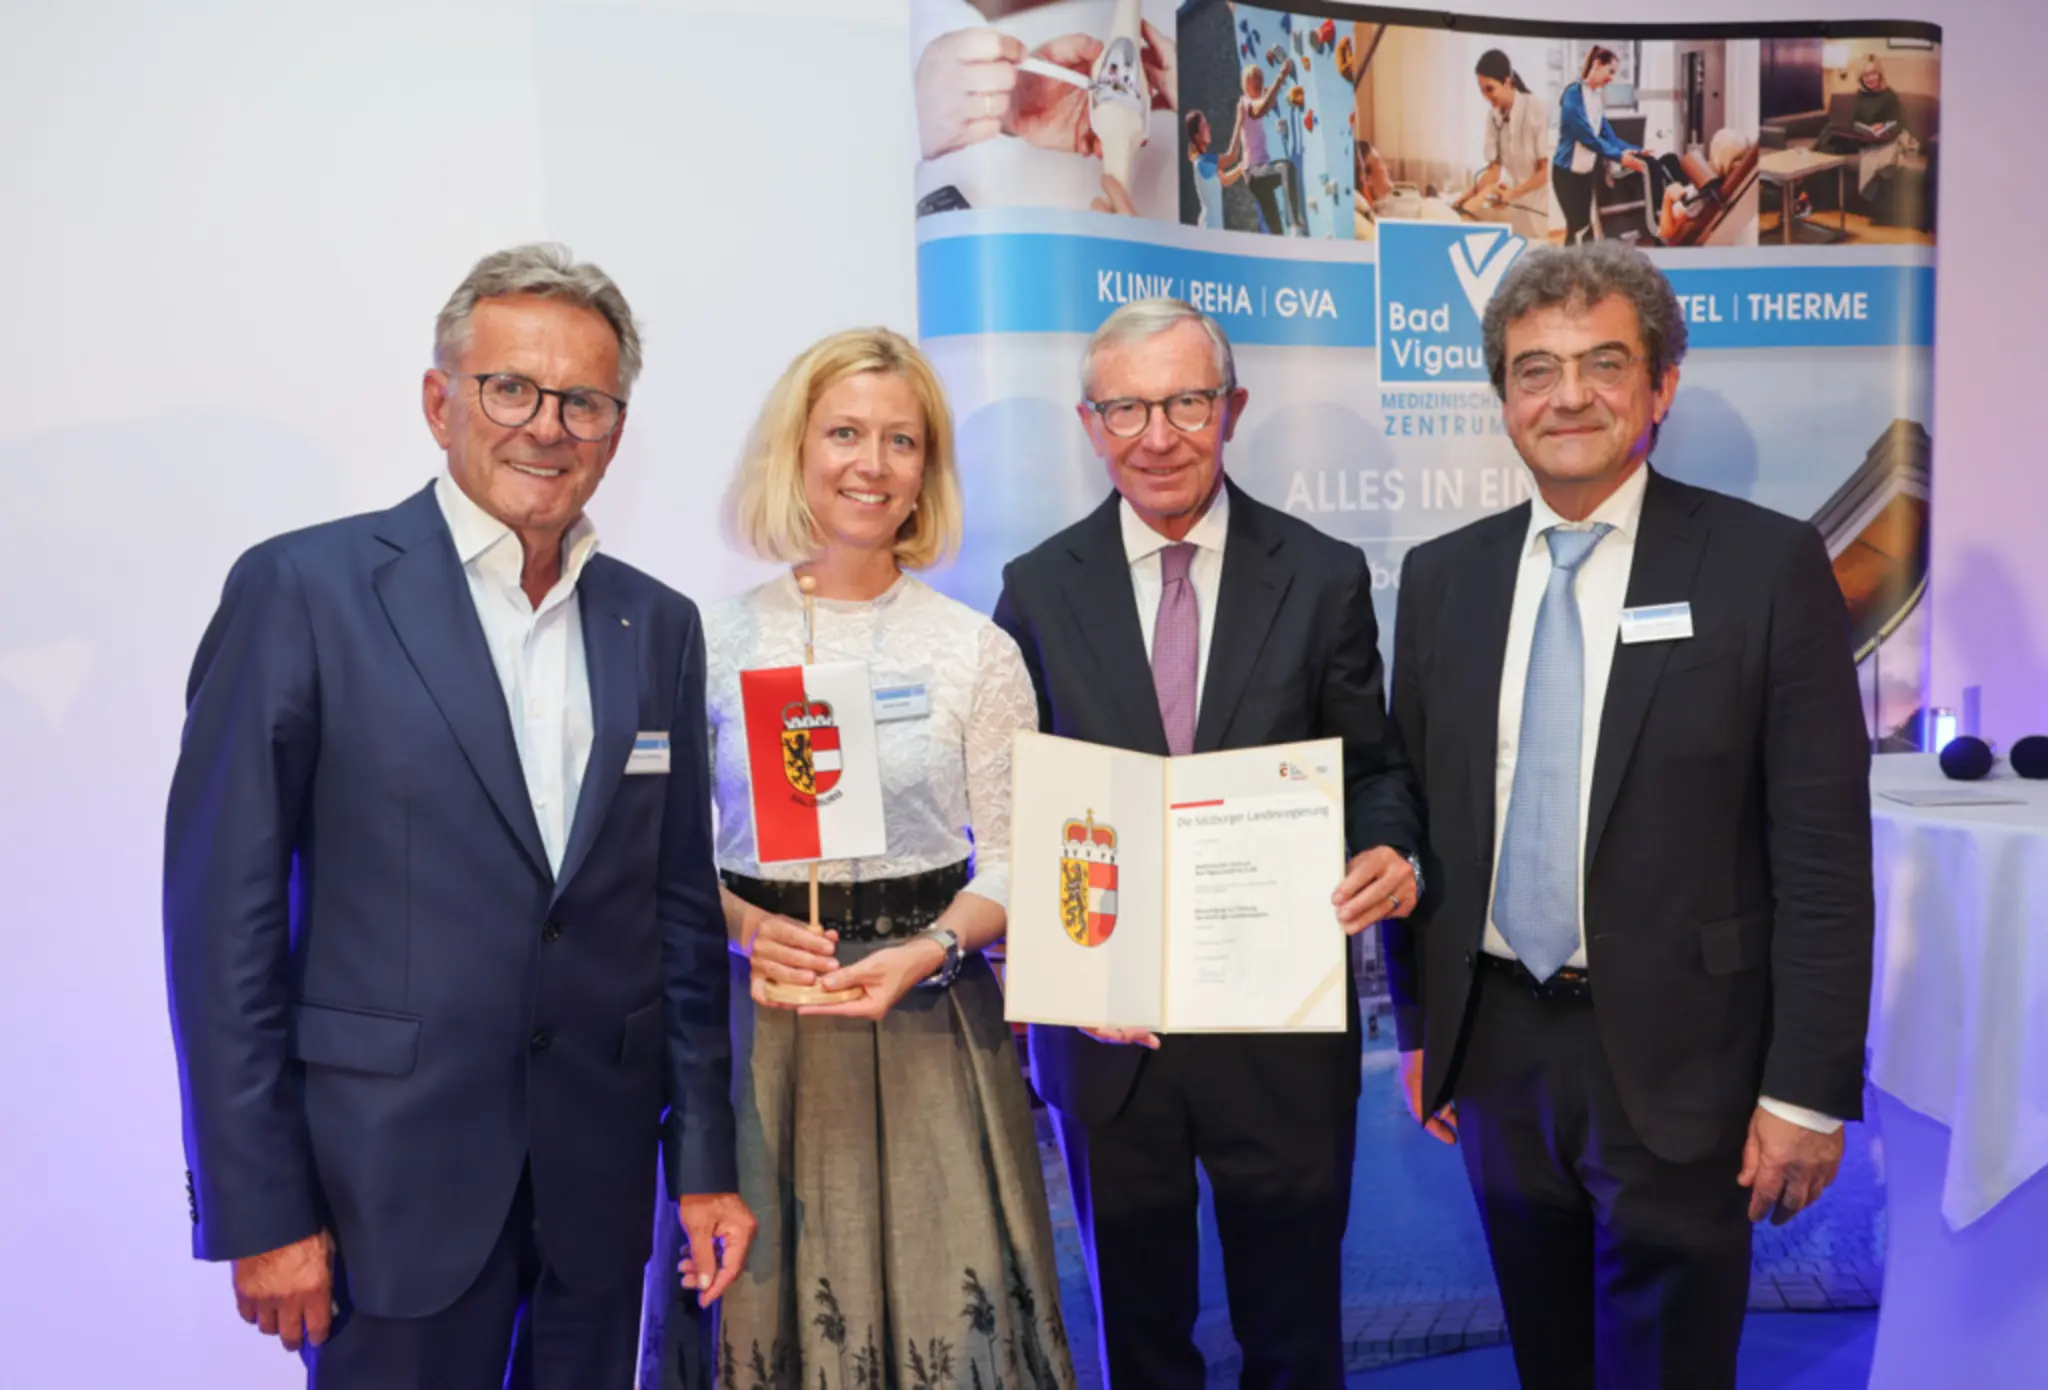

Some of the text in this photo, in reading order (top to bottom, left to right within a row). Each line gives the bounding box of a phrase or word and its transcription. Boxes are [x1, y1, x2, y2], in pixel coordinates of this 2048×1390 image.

[1097, 270, 1338, 319] KLINIK REHA GVA
[1675, 292, 1869, 322] TEL THERME
[1389, 301, 1449, 332] Bad
[1390, 338, 1483, 376] Vigau
[1381, 392, 1501, 410] MEDIZINISCHE
[1286, 467, 1533, 512] ALLES IN EIN
